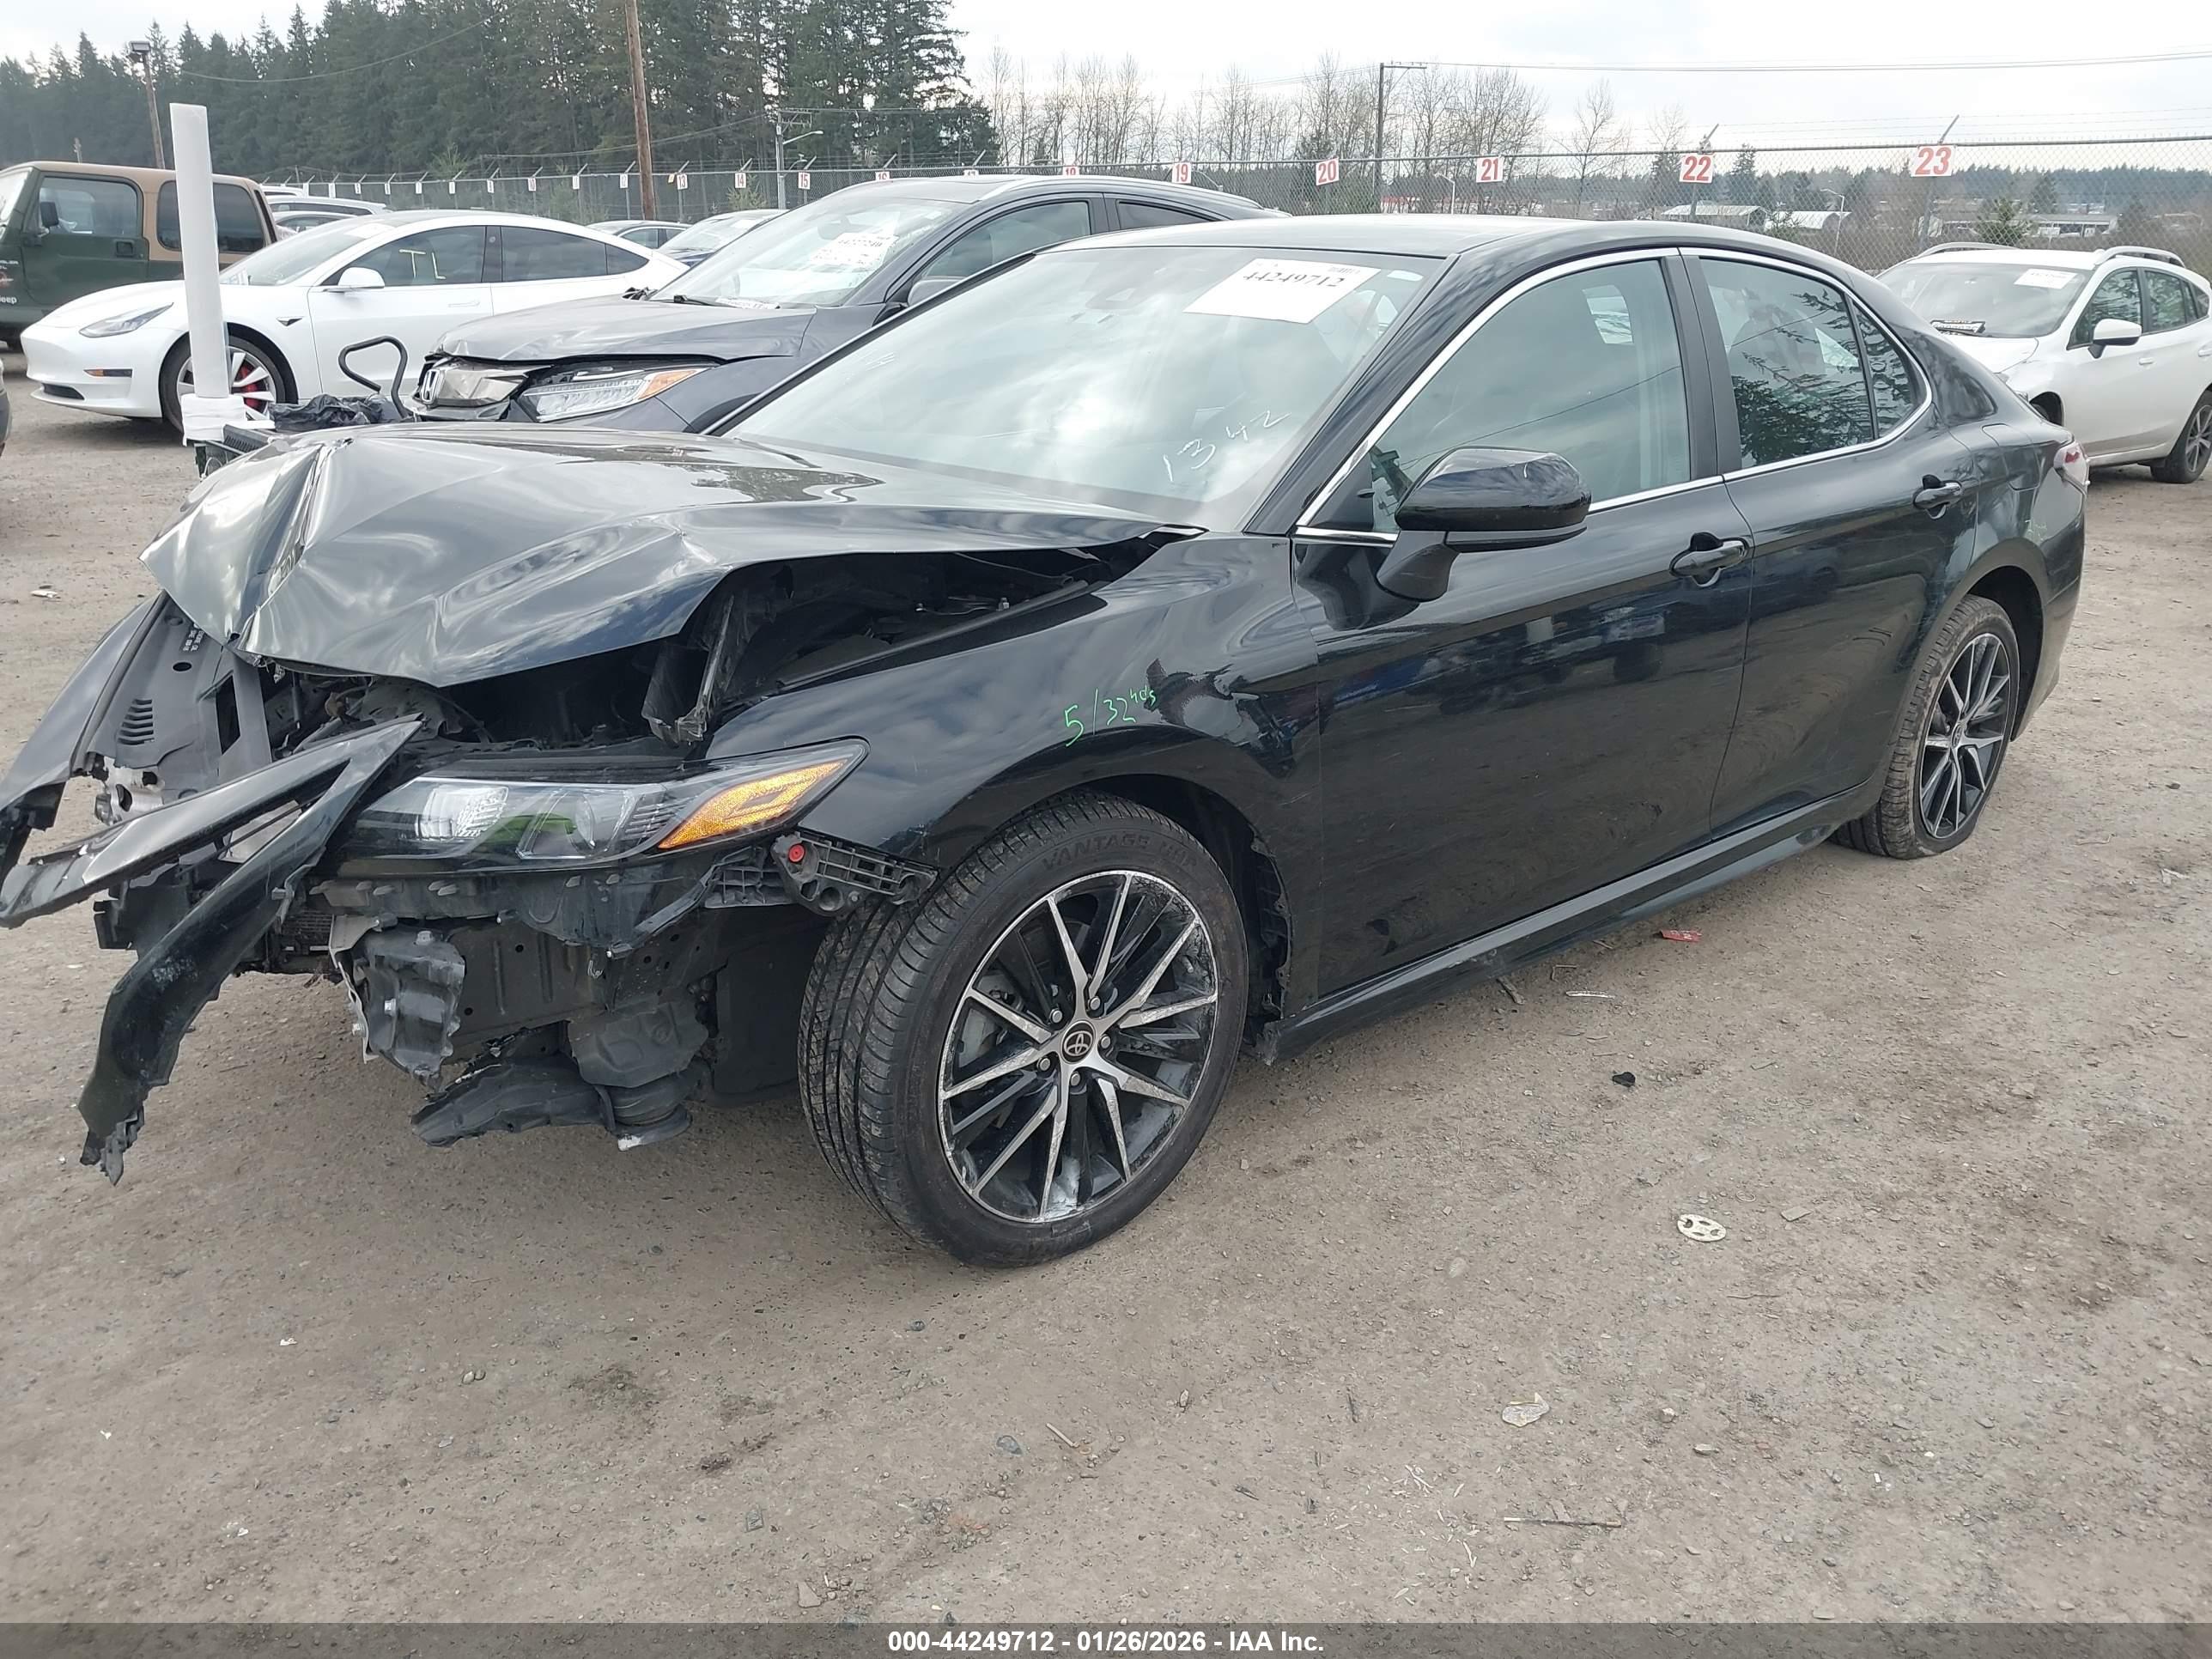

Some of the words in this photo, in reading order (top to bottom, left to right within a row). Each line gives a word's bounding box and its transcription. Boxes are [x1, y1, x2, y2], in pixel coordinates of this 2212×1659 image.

[1480, 158, 1499, 181] 21
[1682, 155, 1712, 181] 22
[1915, 147, 1952, 175] 23
[678, 175, 686, 188] 13
[737, 173, 744, 187] 14
[800, 173, 808, 187] 15
[1175, 163, 1189, 182] 19
[1317, 160, 1338, 184] 20
[1243, 270, 1346, 288] 44249712
[0, 296, 17, 305] eep
[1042, 832, 1151, 870] VANTAGE
